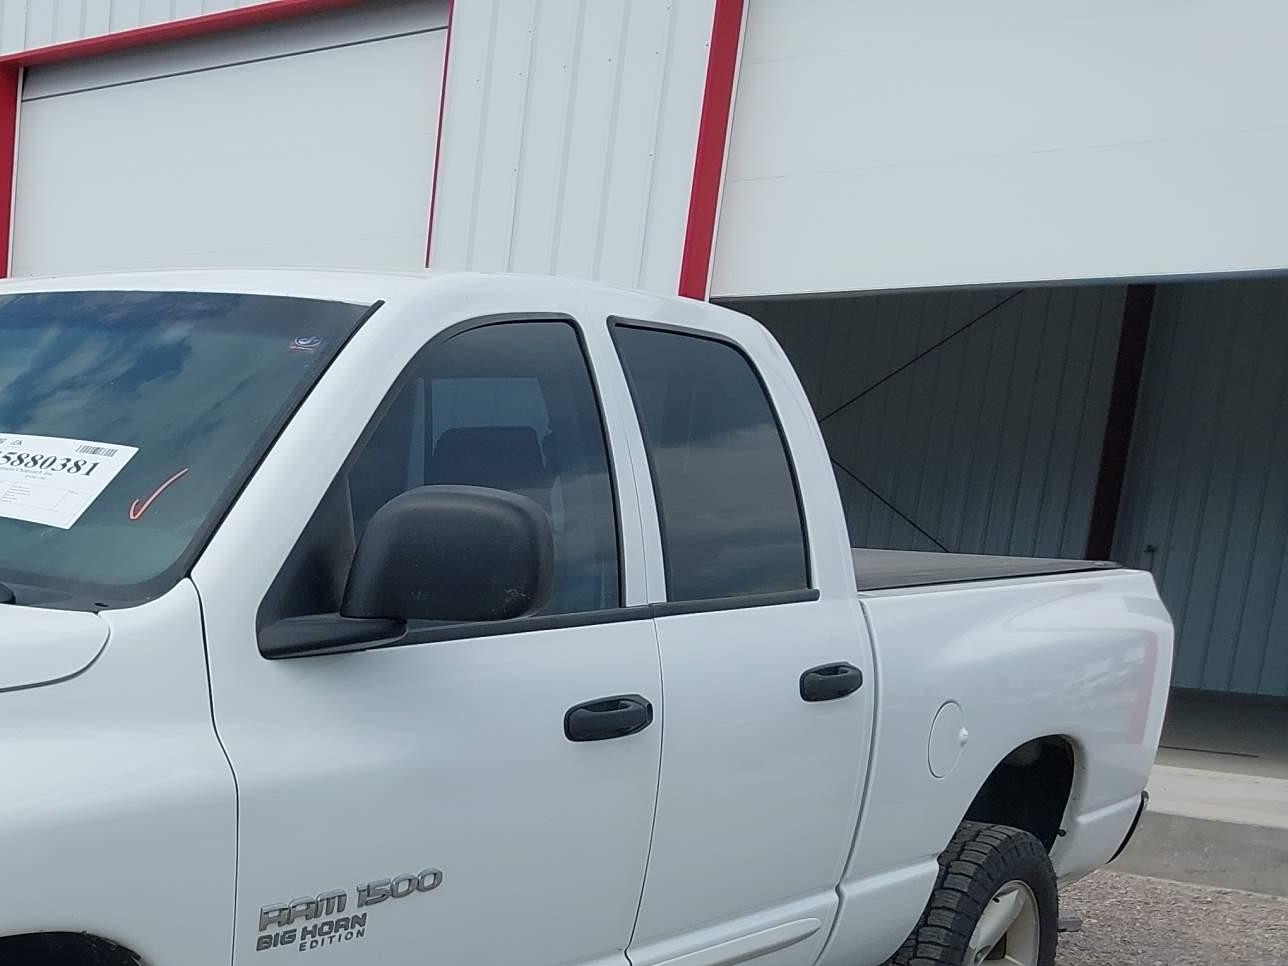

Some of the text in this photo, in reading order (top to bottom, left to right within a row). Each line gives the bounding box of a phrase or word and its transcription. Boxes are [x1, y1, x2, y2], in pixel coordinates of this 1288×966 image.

[259, 868, 444, 932] RAM 1500
[256, 912, 367, 952] BIG HORN
[299, 927, 366, 952] EDITION
